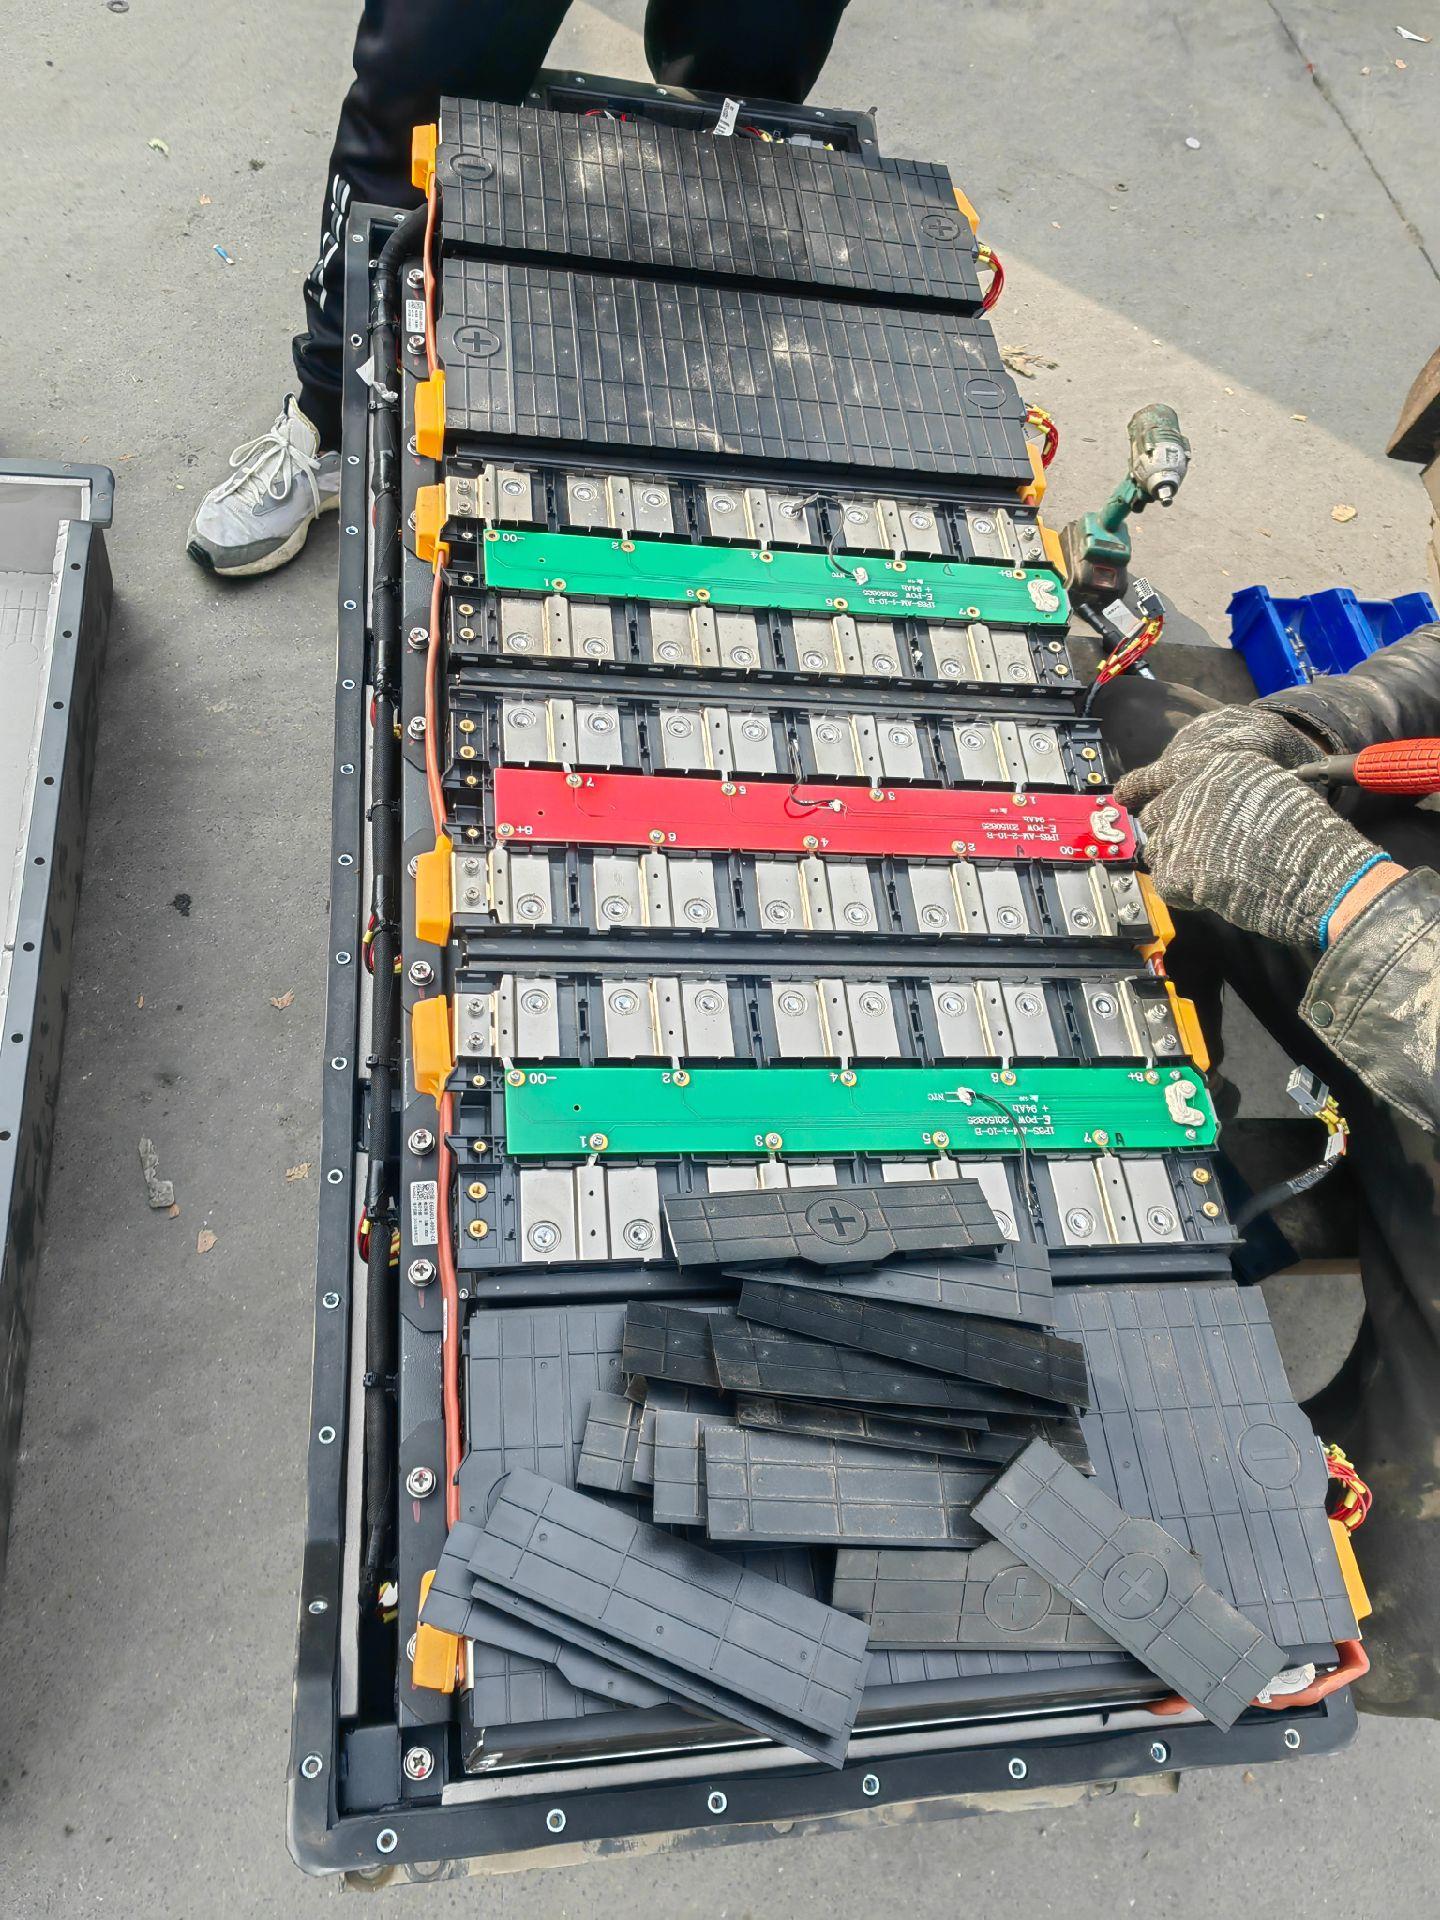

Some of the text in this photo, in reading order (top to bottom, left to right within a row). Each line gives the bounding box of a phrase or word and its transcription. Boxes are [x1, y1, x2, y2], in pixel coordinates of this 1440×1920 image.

[750, 551, 758, 559] 4
[543, 578, 550, 587] 1
[586, 777, 595, 787] 7
[1029, 795, 1037, 805] 1
[668, 832, 677, 842] 6
[820, 837, 829, 847] 4
[967, 842, 976, 852] 2
[662, 1072, 671, 1084] 2
[829, 1072, 838, 1083] 4
[927, 1092, 945, 1101] NTC
[1012, 1104, 1038, 1114] 94Ah
[1018, 1114, 1051, 1125] E-POW
[580, 1135, 587, 1148] 1
[754, 1135, 763, 1147] 3
[922, 1132, 931, 1145] 5
